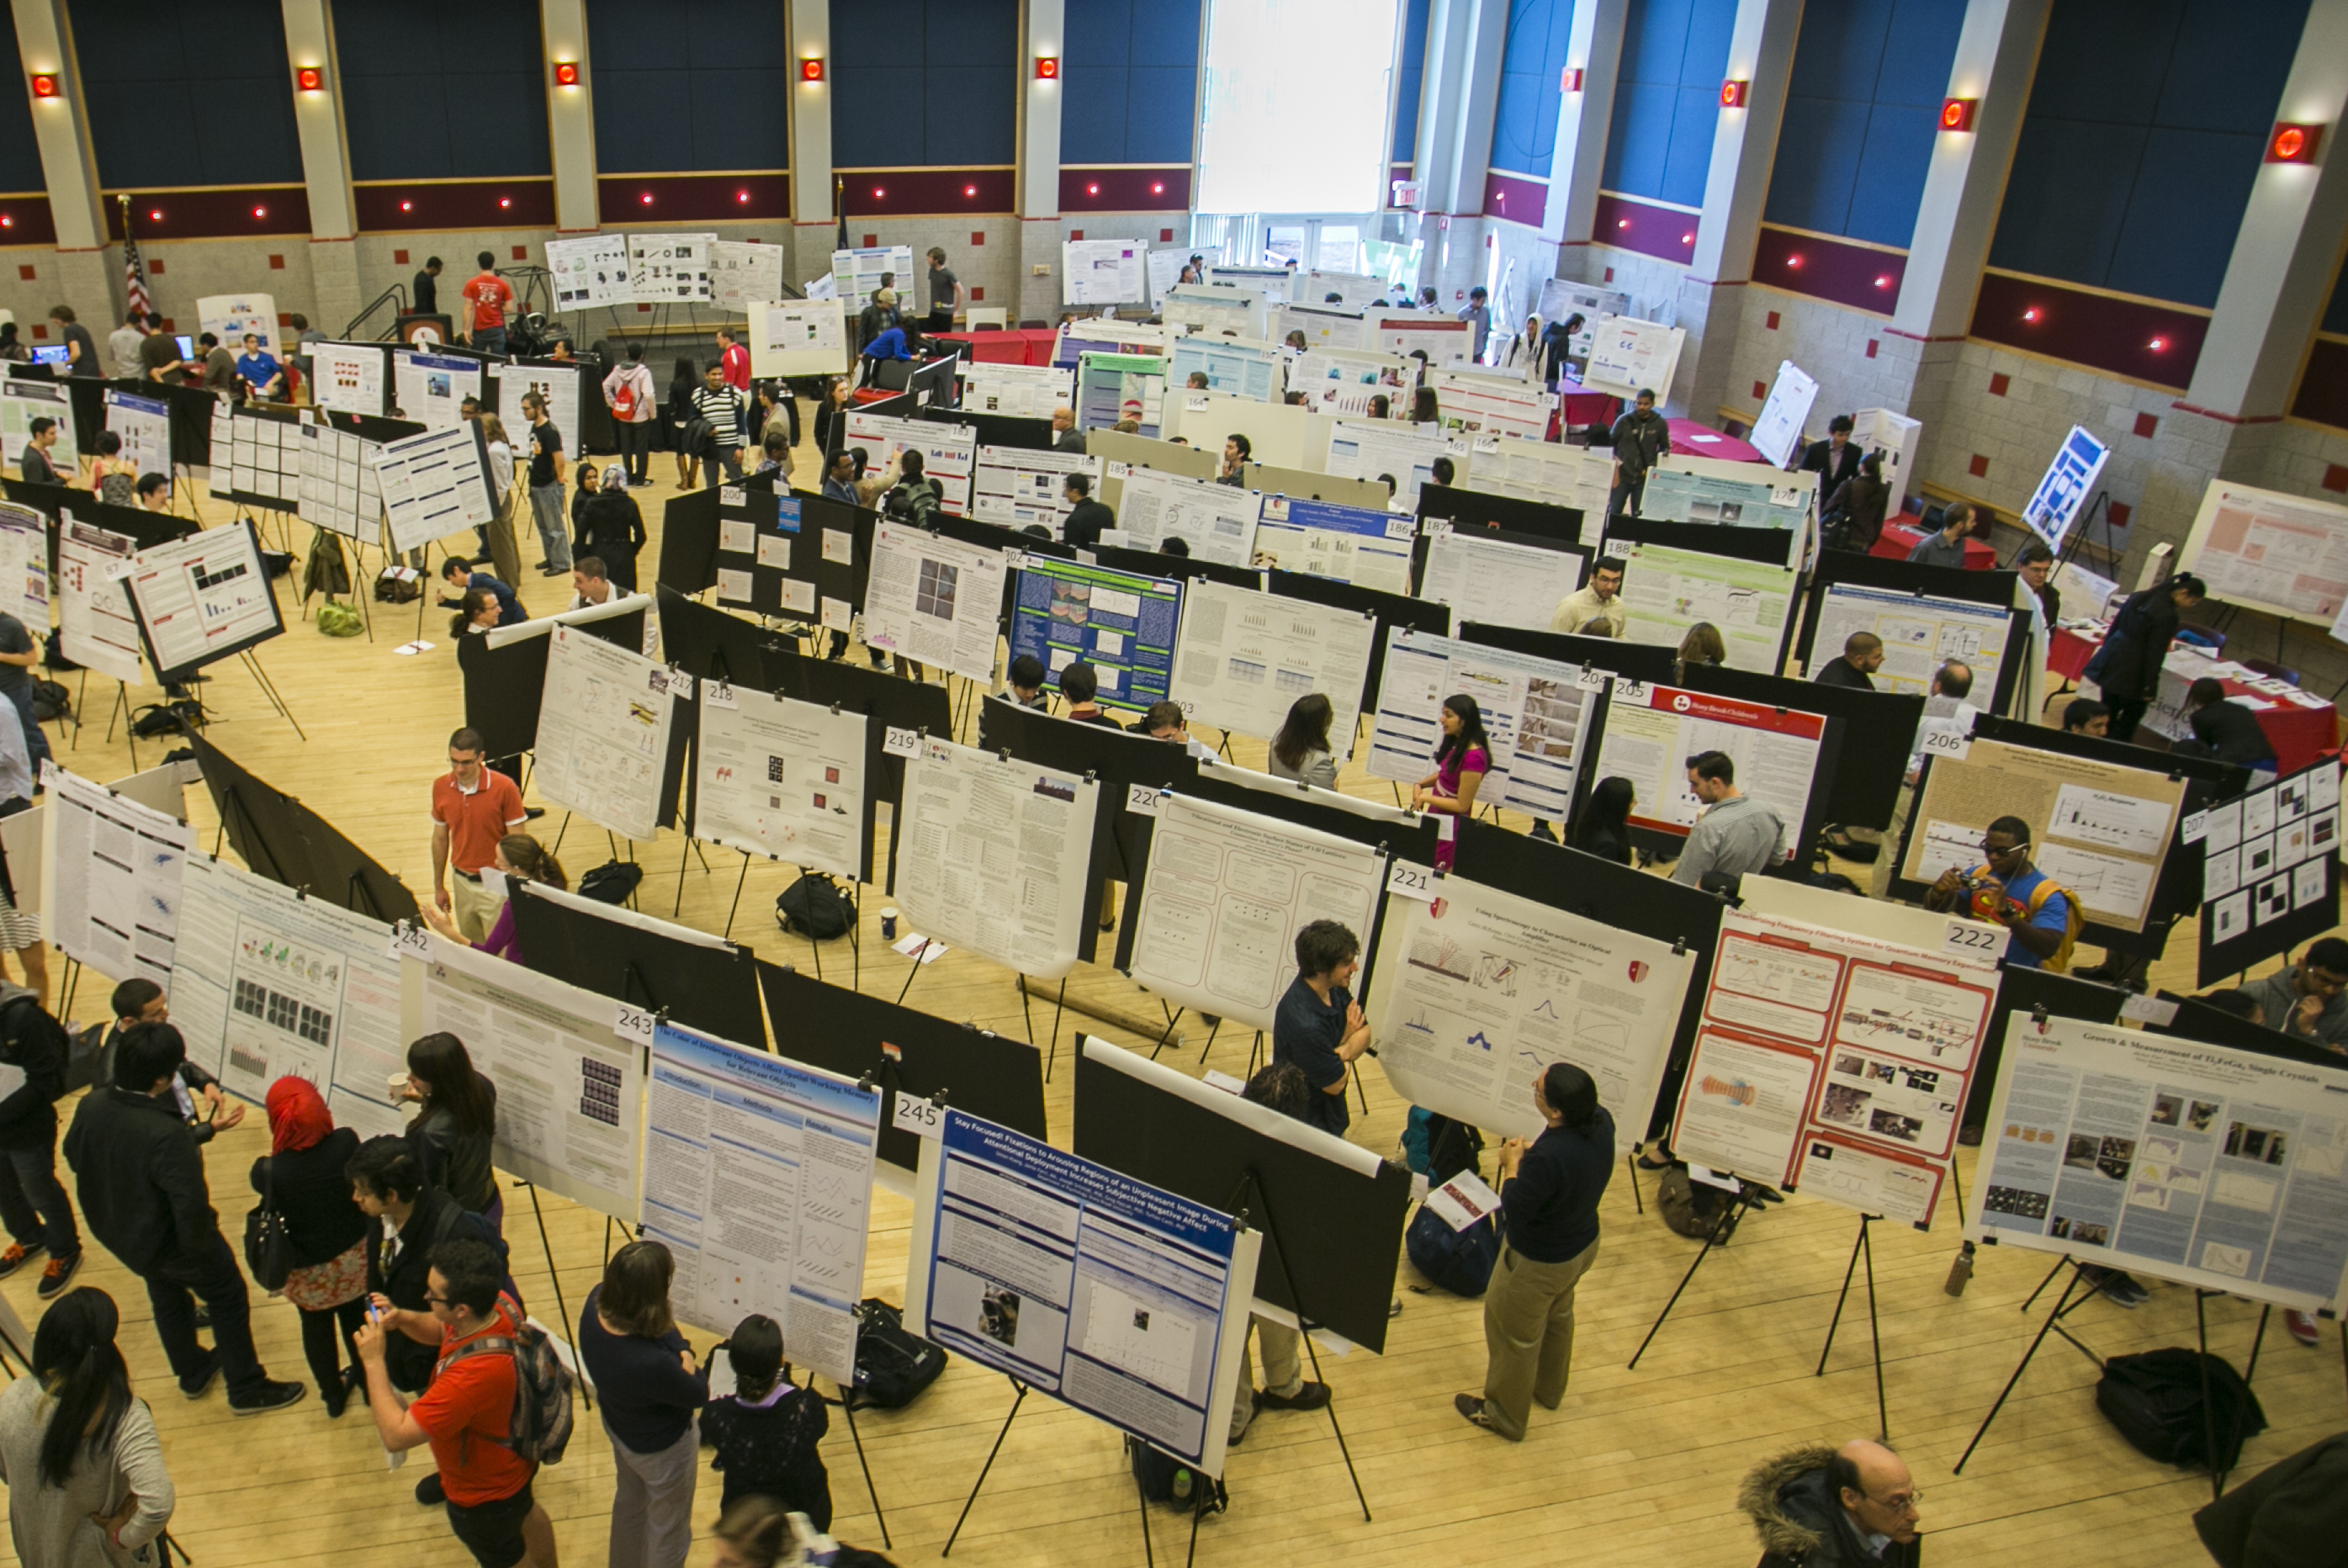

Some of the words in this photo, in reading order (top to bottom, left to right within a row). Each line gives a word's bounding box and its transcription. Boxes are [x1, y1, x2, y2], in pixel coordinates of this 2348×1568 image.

[1401, 189, 1416, 204] EXIT
[953, 426, 968, 436] 183
[1449, 441, 1465, 451] 165
[1477, 439, 1493, 448] 166
[1110, 464, 1126, 474] 185
[1775, 490, 1794, 501] 170
[1390, 522, 1409, 534] 186
[1426, 522, 1445, 532] 187
[1609, 543, 1630, 554] 188
[672, 673, 692, 690] 217
[710, 685, 733, 700] 218
[1616, 682, 1644, 697] 205
[1692, 702, 1709, 713] Stony
[1709, 704, 1727, 714] Brook
[888, 732, 914, 749] 219
[1927, 734, 1960, 750] 206
[2186, 816, 2204, 834] 207
[1394, 868, 1427, 890] 221
[403, 928, 427, 951] 242
[1949, 927, 1995, 950] 222
[619, 1009, 652, 1036] 243
[2083, 1032, 2117, 1046] Growth
[899, 1099, 936, 1126] 245
[805, 1118, 832, 1135] Results
[954, 1116, 971, 1132] Stay
[971, 1123, 1004, 1143] Focused!
[1004, 1136, 1037, 1156] Fixations
[1038, 1149, 1047, 1160] to
[1047, 1152, 1079, 1175] Arousing
[1080, 1166, 1110, 1184] Regions
[1110, 1179, 1120, 1189] of
[1120, 1184, 1131, 1193] an
[1132, 1186, 1175, 1210] Unpleasant
[1177, 1204, 1201, 1221] Image
[1201, 1213, 1230, 1234] During
[983, 1137, 1025, 1161] Attentional
[1025, 1153, 1068, 1179] Deployment
[1068, 1171, 1105, 1193] Increases
[1105, 1185, 1146, 1209] Subjective
[1147, 1202, 1183, 1223] Negative
[1182, 1216, 1208, 1233] Affect
